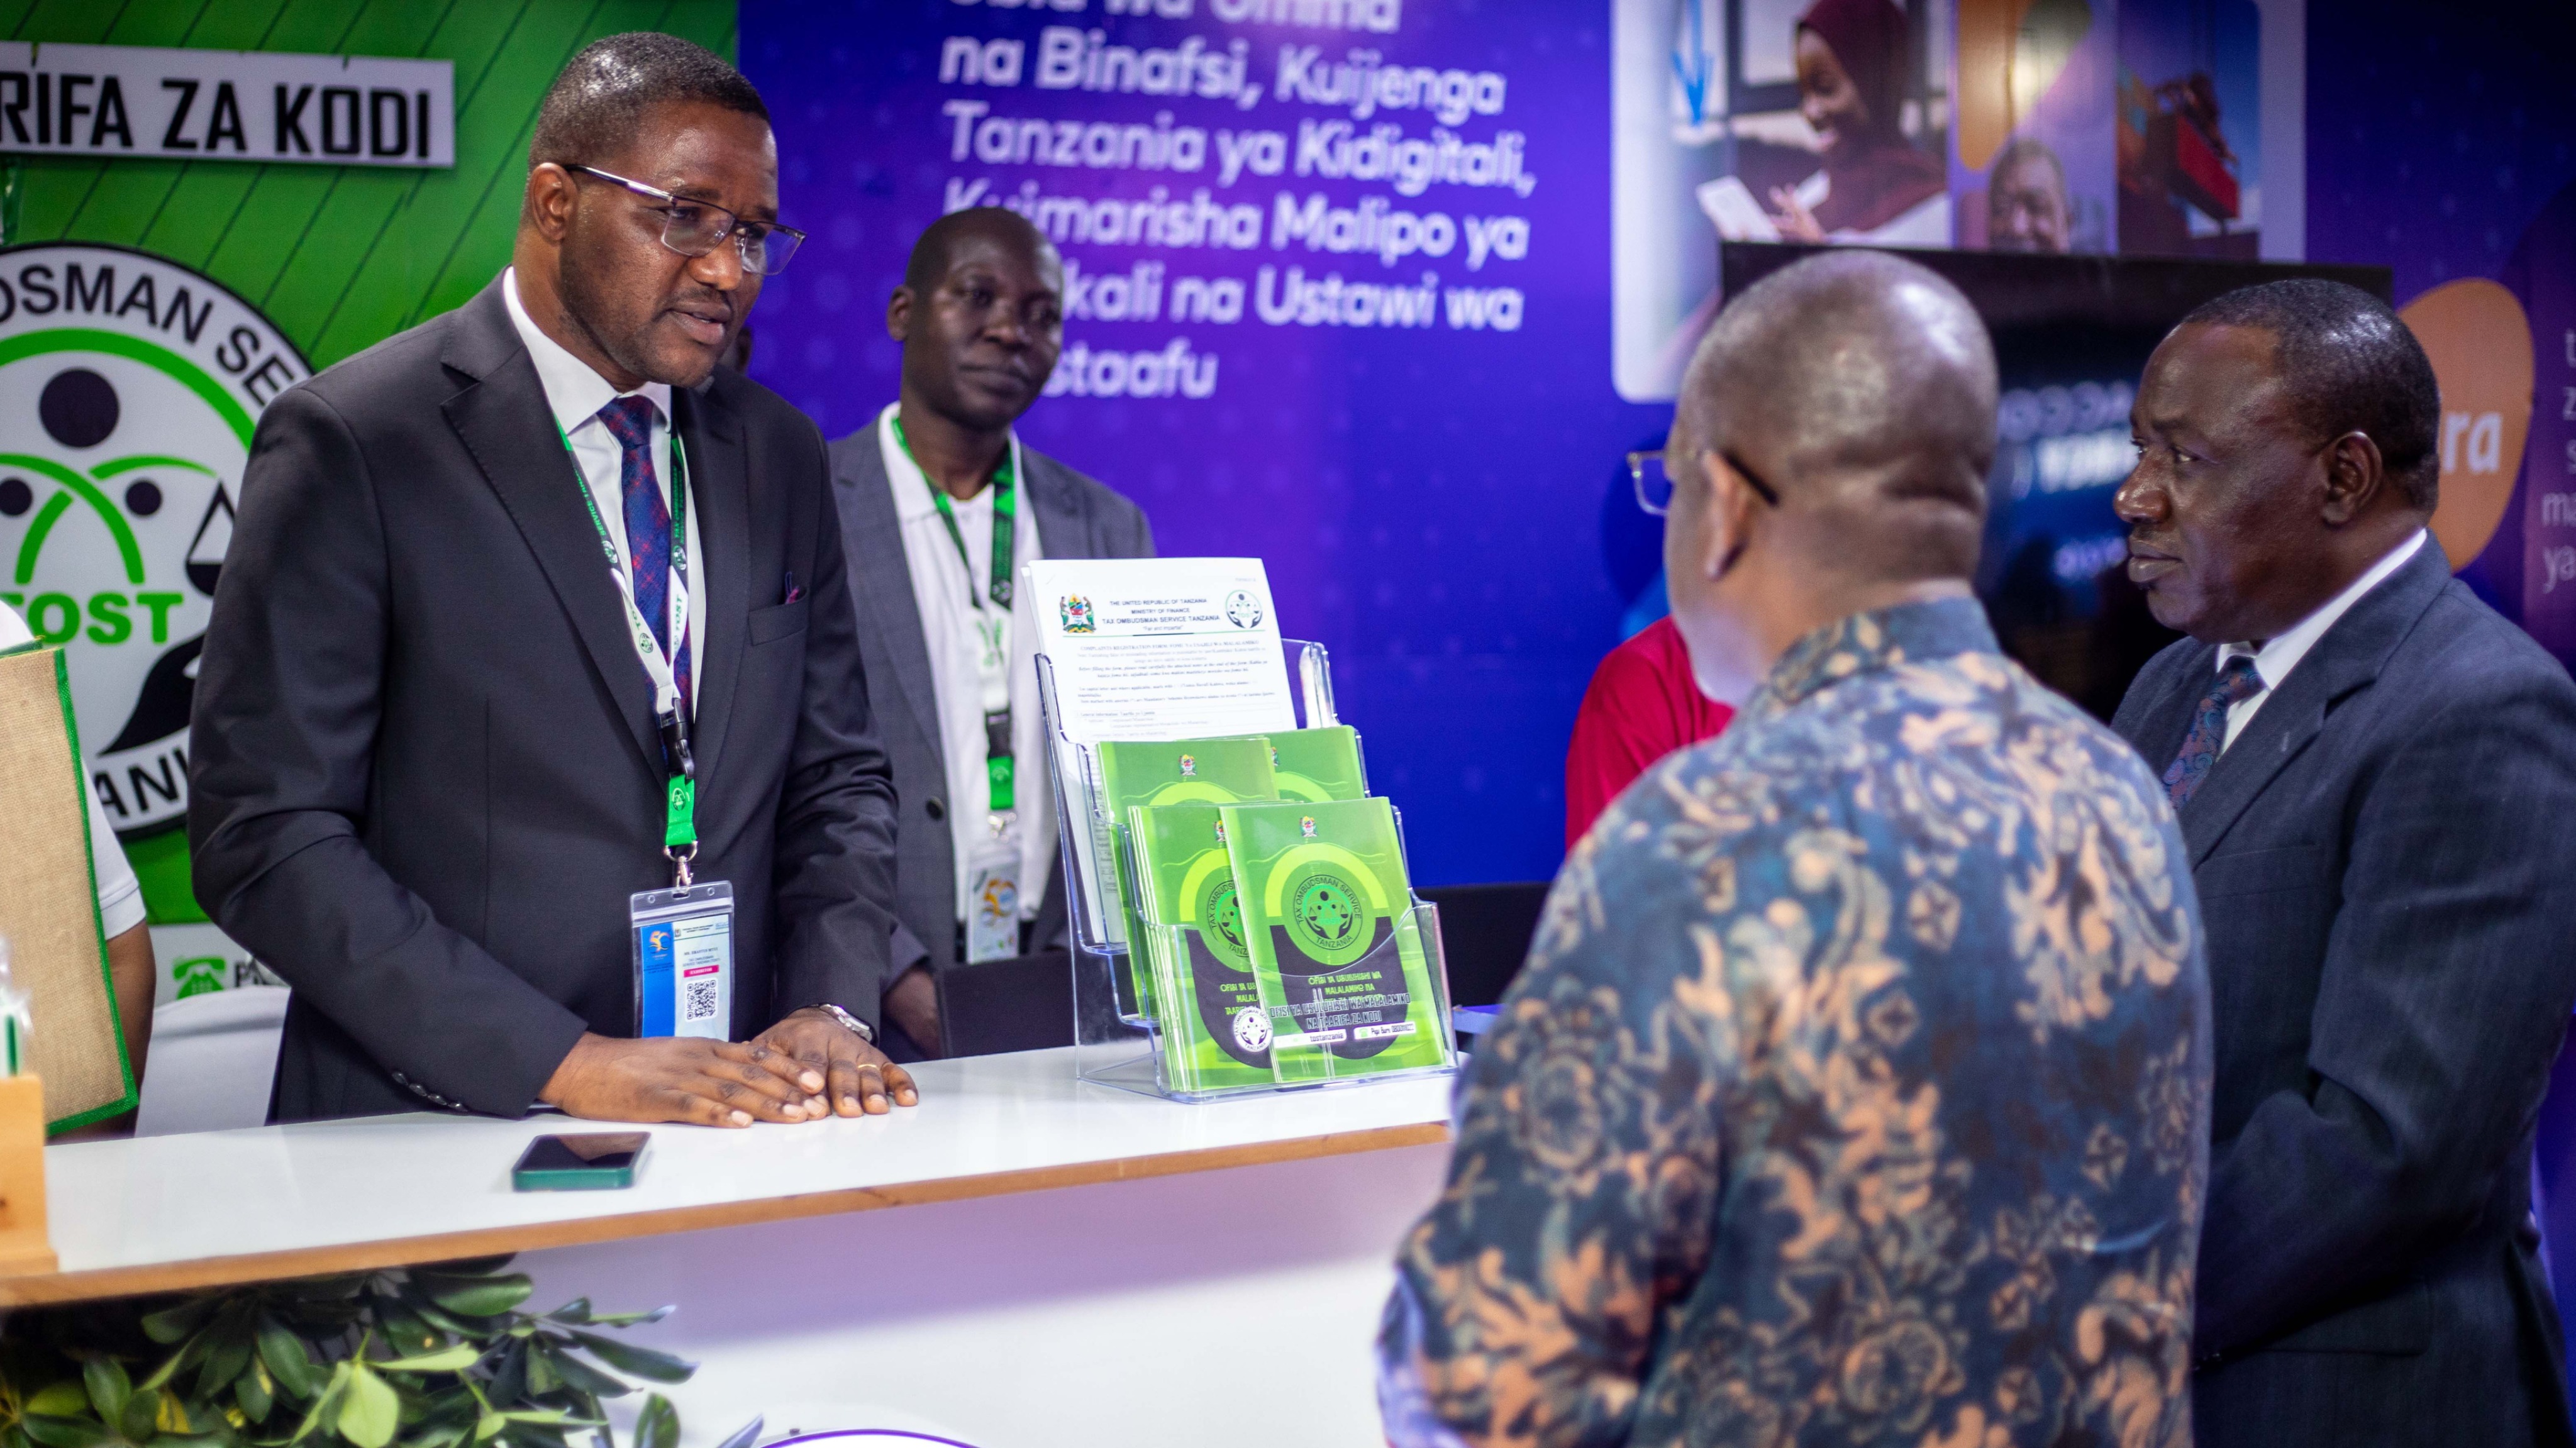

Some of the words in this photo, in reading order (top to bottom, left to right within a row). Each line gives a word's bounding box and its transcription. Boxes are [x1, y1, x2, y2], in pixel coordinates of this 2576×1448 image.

[939, 36, 1025, 87] na
[1035, 25, 1263, 111] Binafsi,
[1274, 43, 1507, 127] Kuijenga
[0, 71, 133, 148] RIFA
[162, 79, 246, 152] ZA
[275, 83, 430, 158] KODI
[942, 99, 1206, 172] Tanzania
[1214, 128, 1287, 187] ya
[1294, 118, 1536, 199] Kidigitali,
[943, 177, 1263, 250] Kimarisha
[1269, 190, 1458, 268] Malipo
[1462, 214, 1531, 272] ya
[1062, 258, 1166, 323] kali
[1169, 277, 1246, 324] na
[1255, 264, 1440, 328] Ustawi
[1443, 286, 1524, 331] wa
[215, 323, 296, 409] SE
[586, 500, 607, 536] SERVICE
[0, 592, 184, 646] OST
[1209, 883, 1235, 910] OMBUDS
[1296, 877, 1339, 905] OMBUDSMAN
[1340, 884, 1362, 919] SERVICE
[1296, 907, 1304, 924] TAX
[1228, 943, 1249, 956] TANZ
[1316, 935, 1353, 948] TANZANIA
[1220, 983, 1238, 992] OFISI
[1247, 982, 1257, 990] US
[1308, 976, 1326, 985] OFISI
[1270, 1005, 1290, 1018] OFISI
[1291, 1003, 1303, 1017] YA
[1352, 1012, 1363, 1024] ZA
[1363, 1010, 1382, 1023] KODI
[1310, 1032, 1344, 1042] tostanzania
